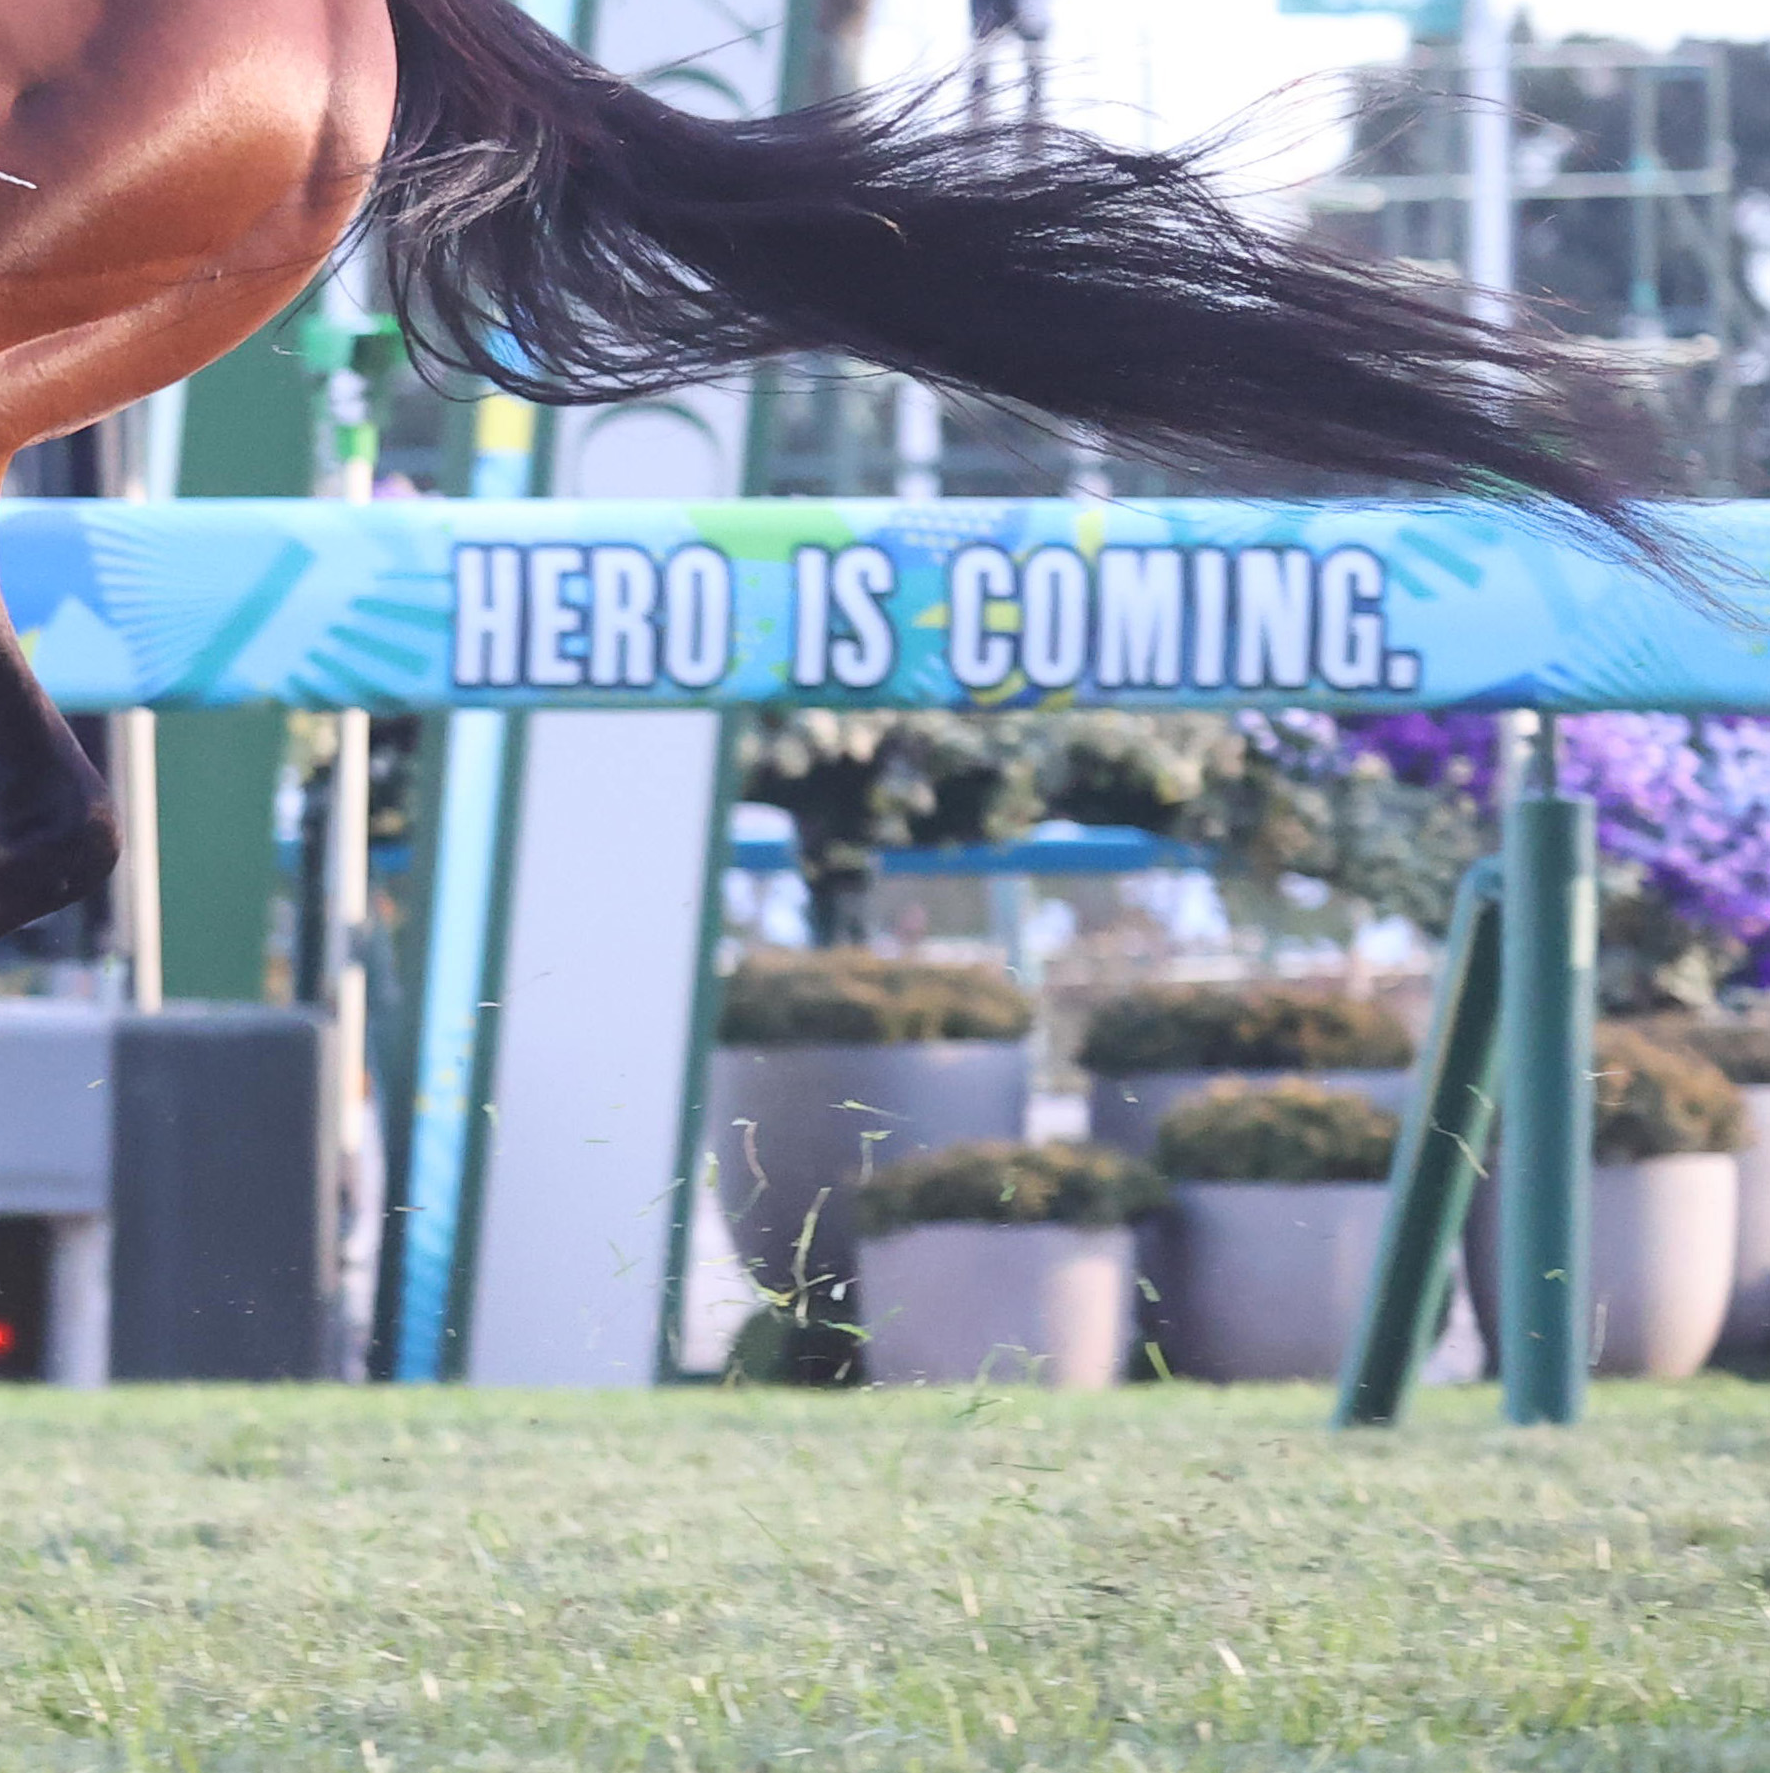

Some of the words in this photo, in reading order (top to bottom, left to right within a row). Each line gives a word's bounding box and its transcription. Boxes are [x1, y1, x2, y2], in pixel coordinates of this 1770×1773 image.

[455, 543, 732, 688] HERO
[792, 544, 896, 688] IS
[948, 544, 1420, 690] COMING.
